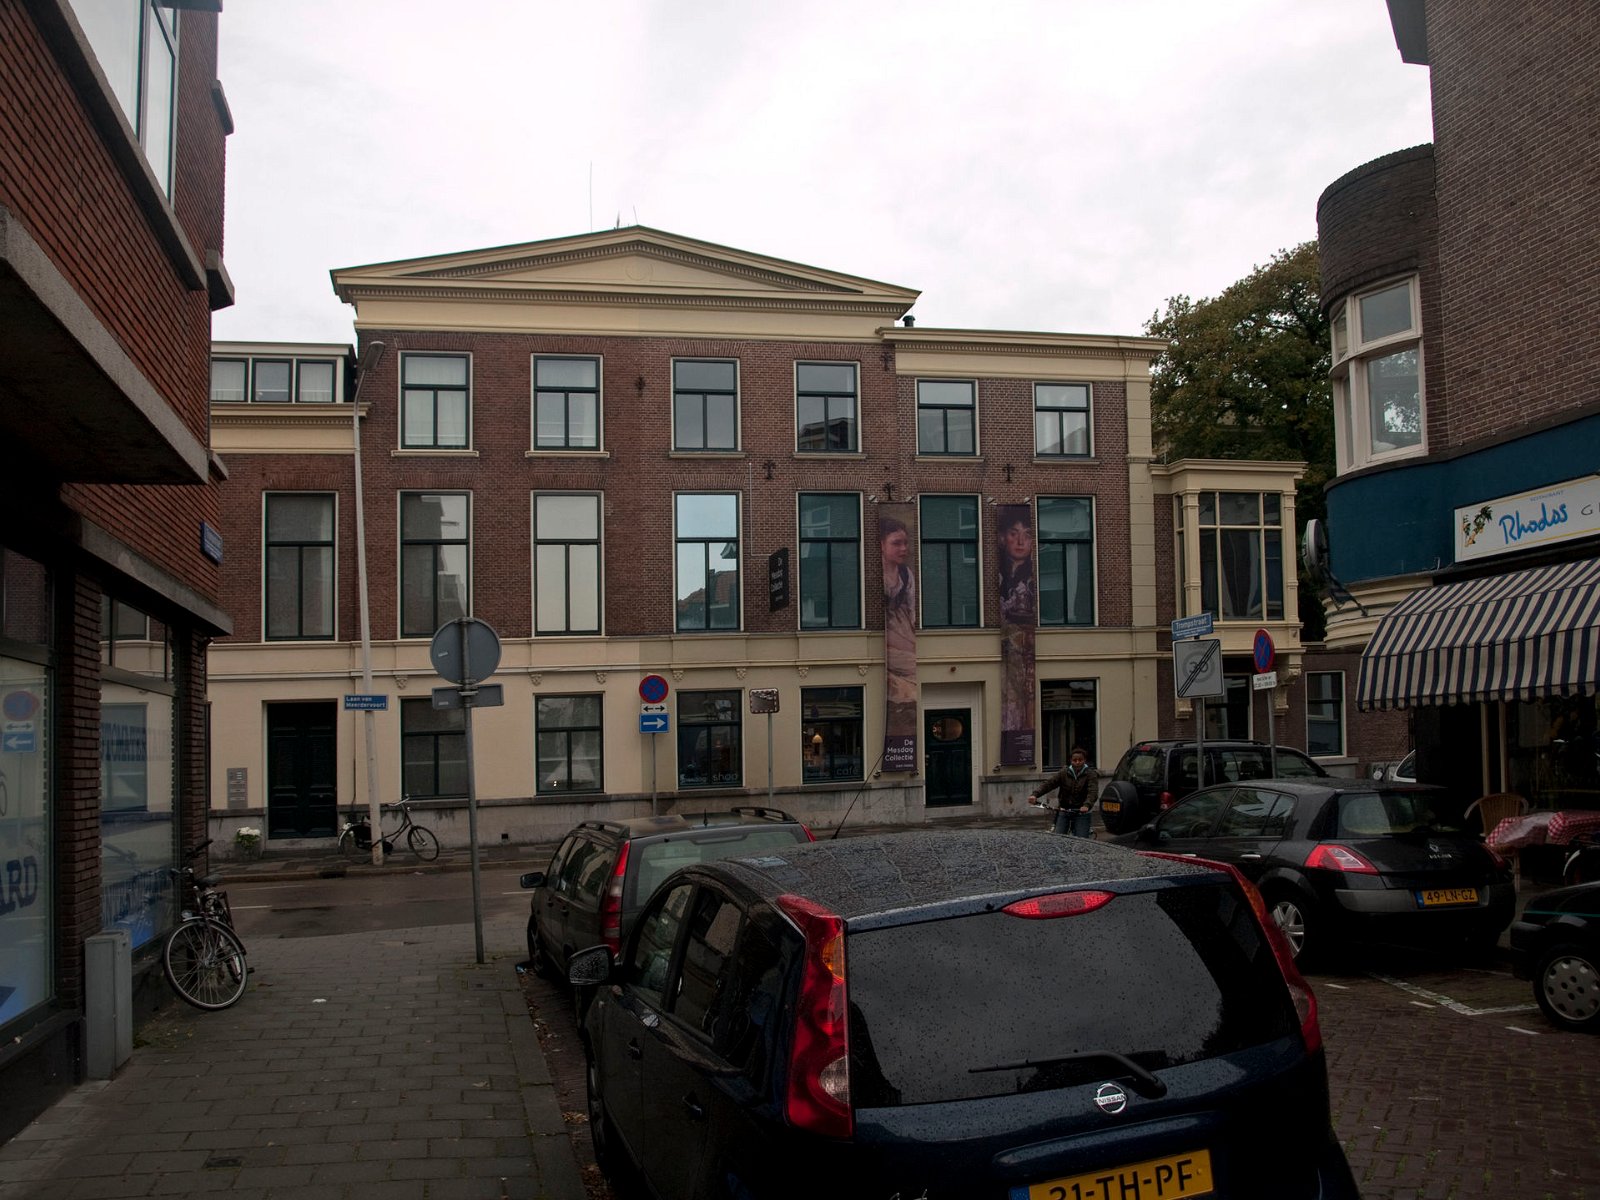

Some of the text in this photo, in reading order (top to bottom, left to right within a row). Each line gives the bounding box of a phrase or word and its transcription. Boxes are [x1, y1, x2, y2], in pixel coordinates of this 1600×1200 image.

[1580, 501, 1600, 516] G
[887, 746, 914, 754] Mesdag
[884, 754, 914, 762] Collectie
[1098, 1093, 1126, 1105] NISSAN
